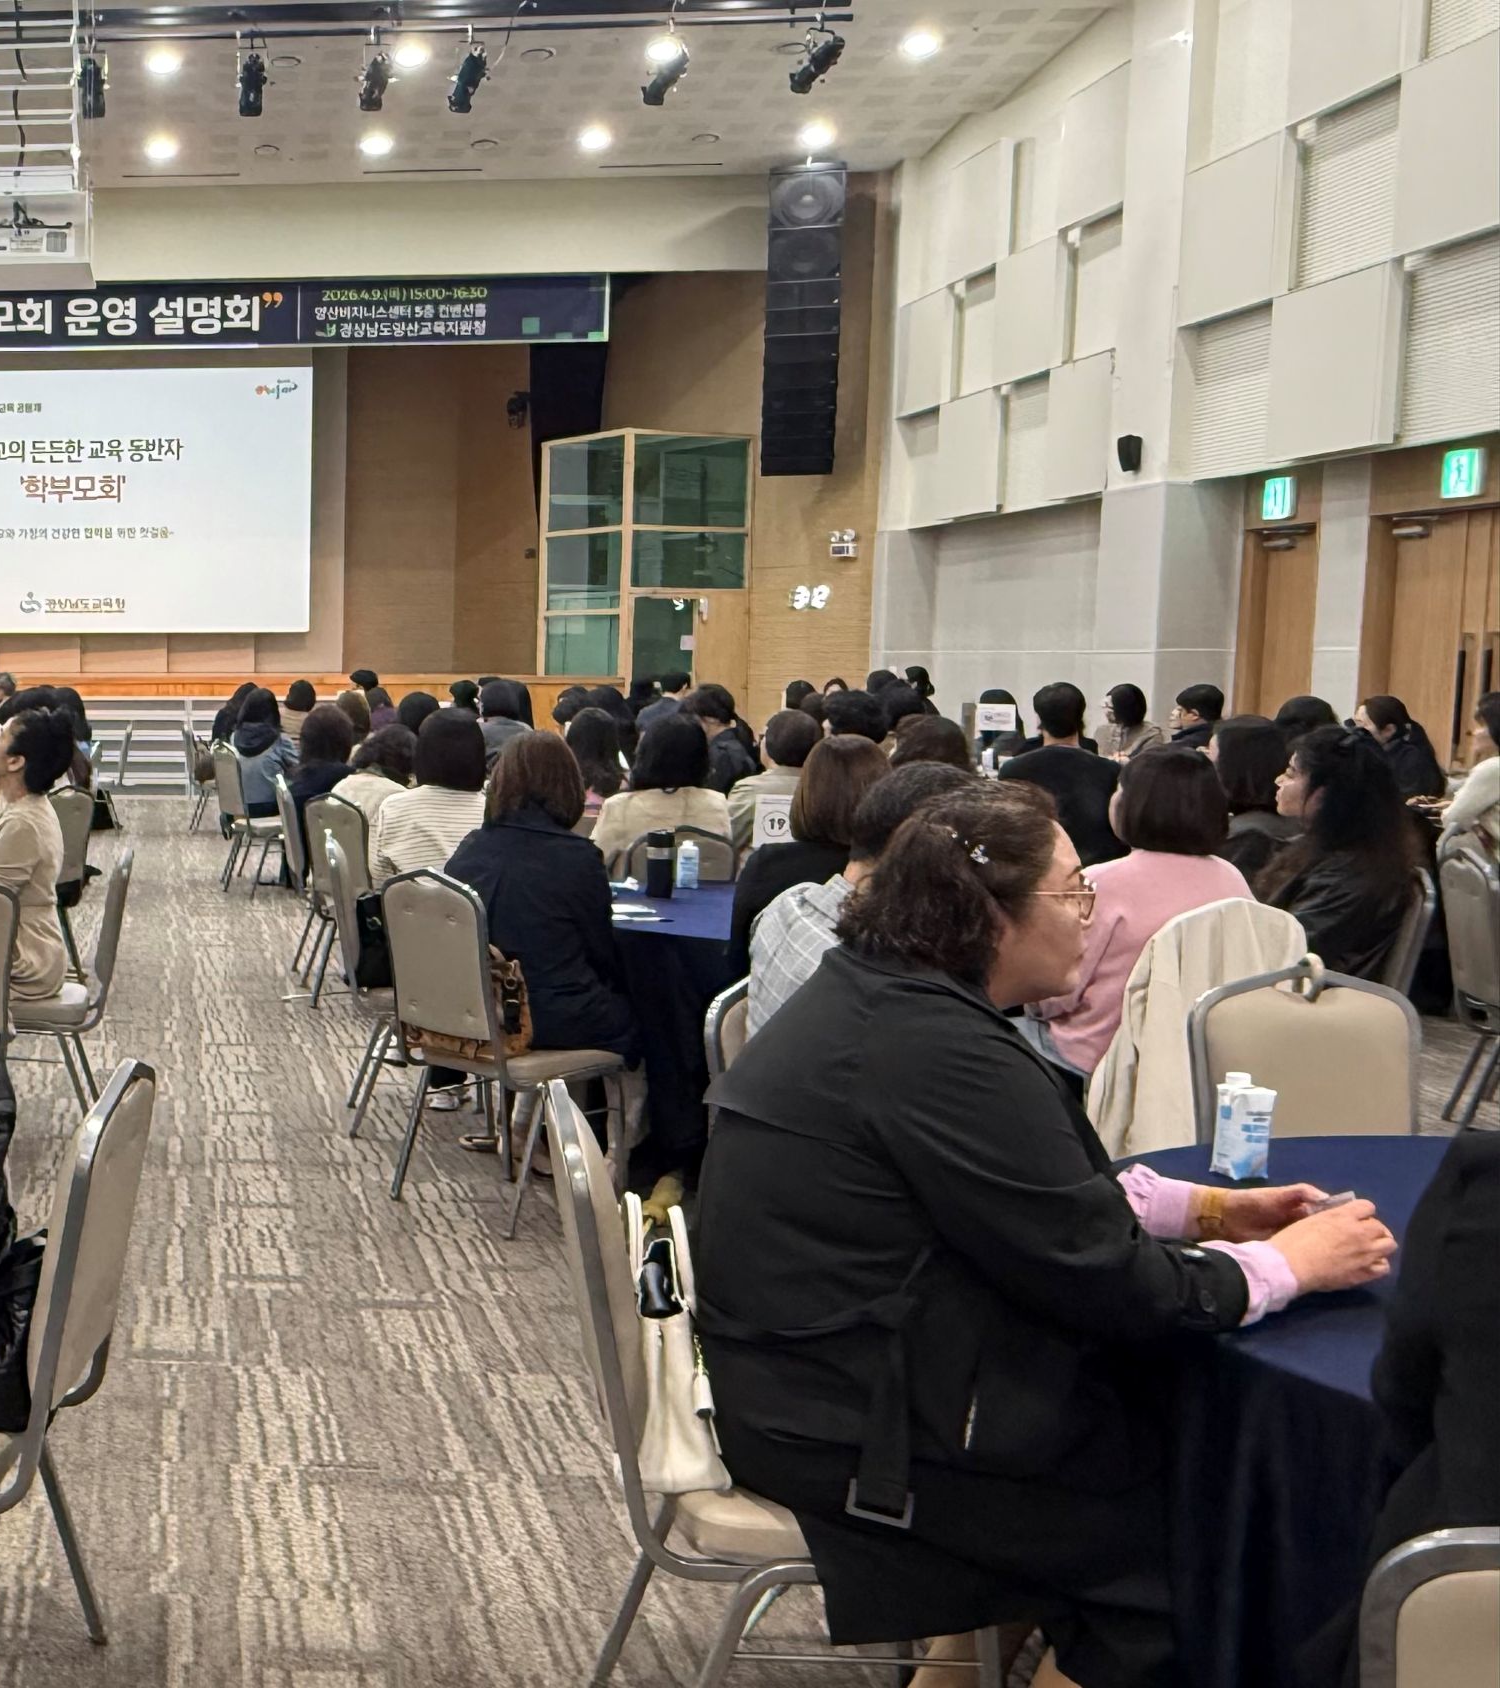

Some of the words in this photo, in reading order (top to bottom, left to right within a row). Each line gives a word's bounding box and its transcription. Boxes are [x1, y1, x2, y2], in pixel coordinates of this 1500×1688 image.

[64, 297, 138, 337] 운영
[414, 303, 436, 319] 5층
[339, 319, 487, 338] 경상남도양산교육지원청
[29, 439, 85, 464] 든든한
[87, 439, 125, 463] 교육
[127, 438, 185, 463] 동반자
[768, 818, 786, 830] 19
